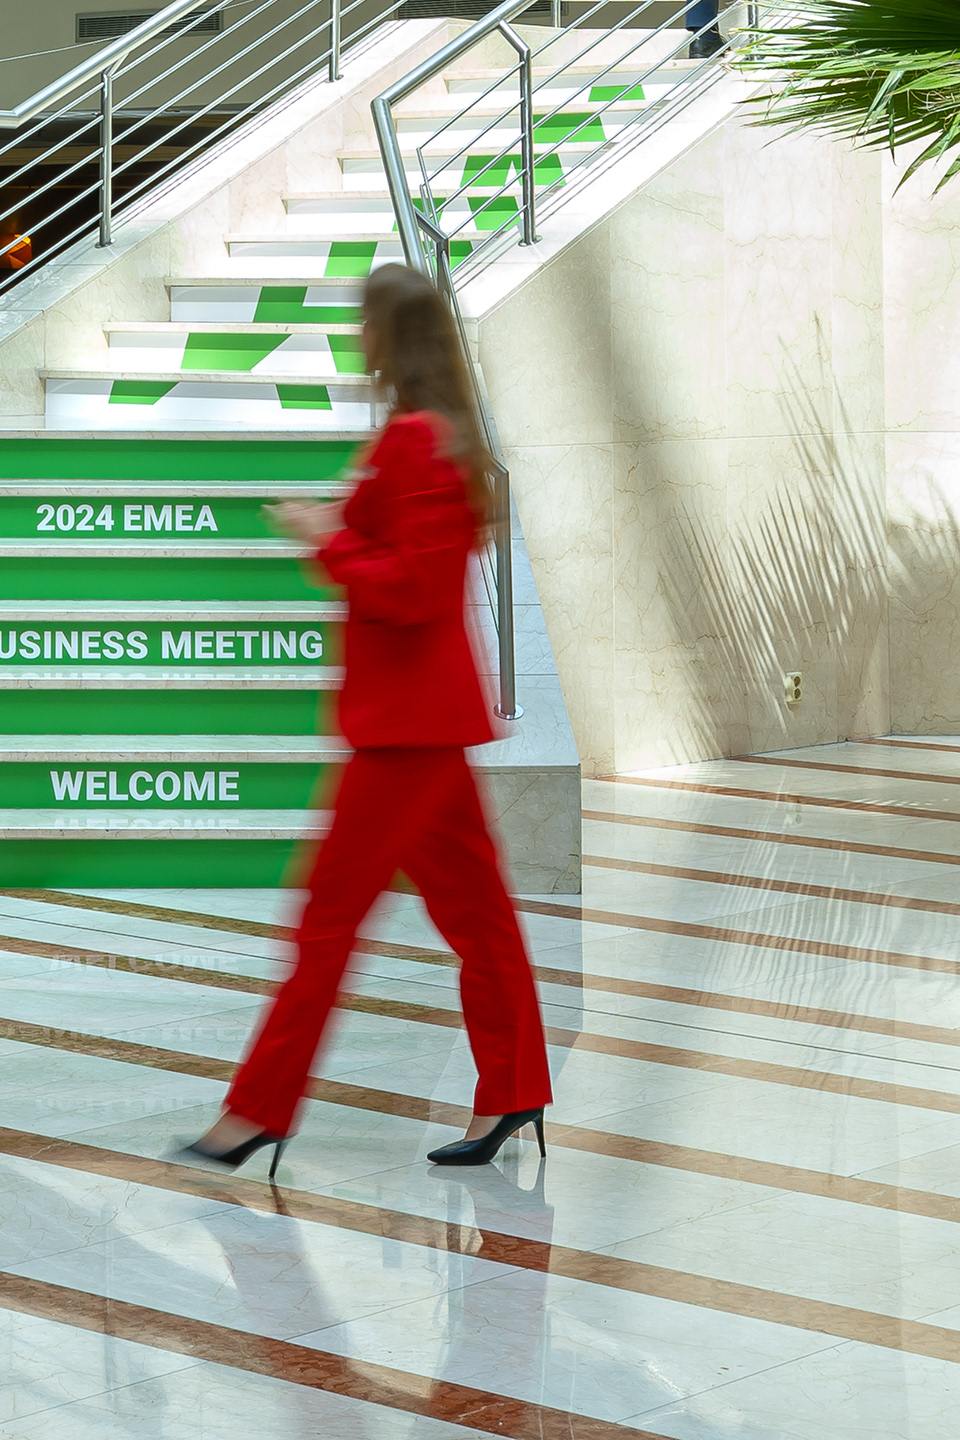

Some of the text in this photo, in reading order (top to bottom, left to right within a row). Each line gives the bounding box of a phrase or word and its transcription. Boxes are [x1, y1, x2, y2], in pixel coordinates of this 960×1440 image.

[36, 504, 219, 532] 2024 EMEA
[161, 630, 323, 660] MEETING
[49, 770, 240, 802] WELCOME
